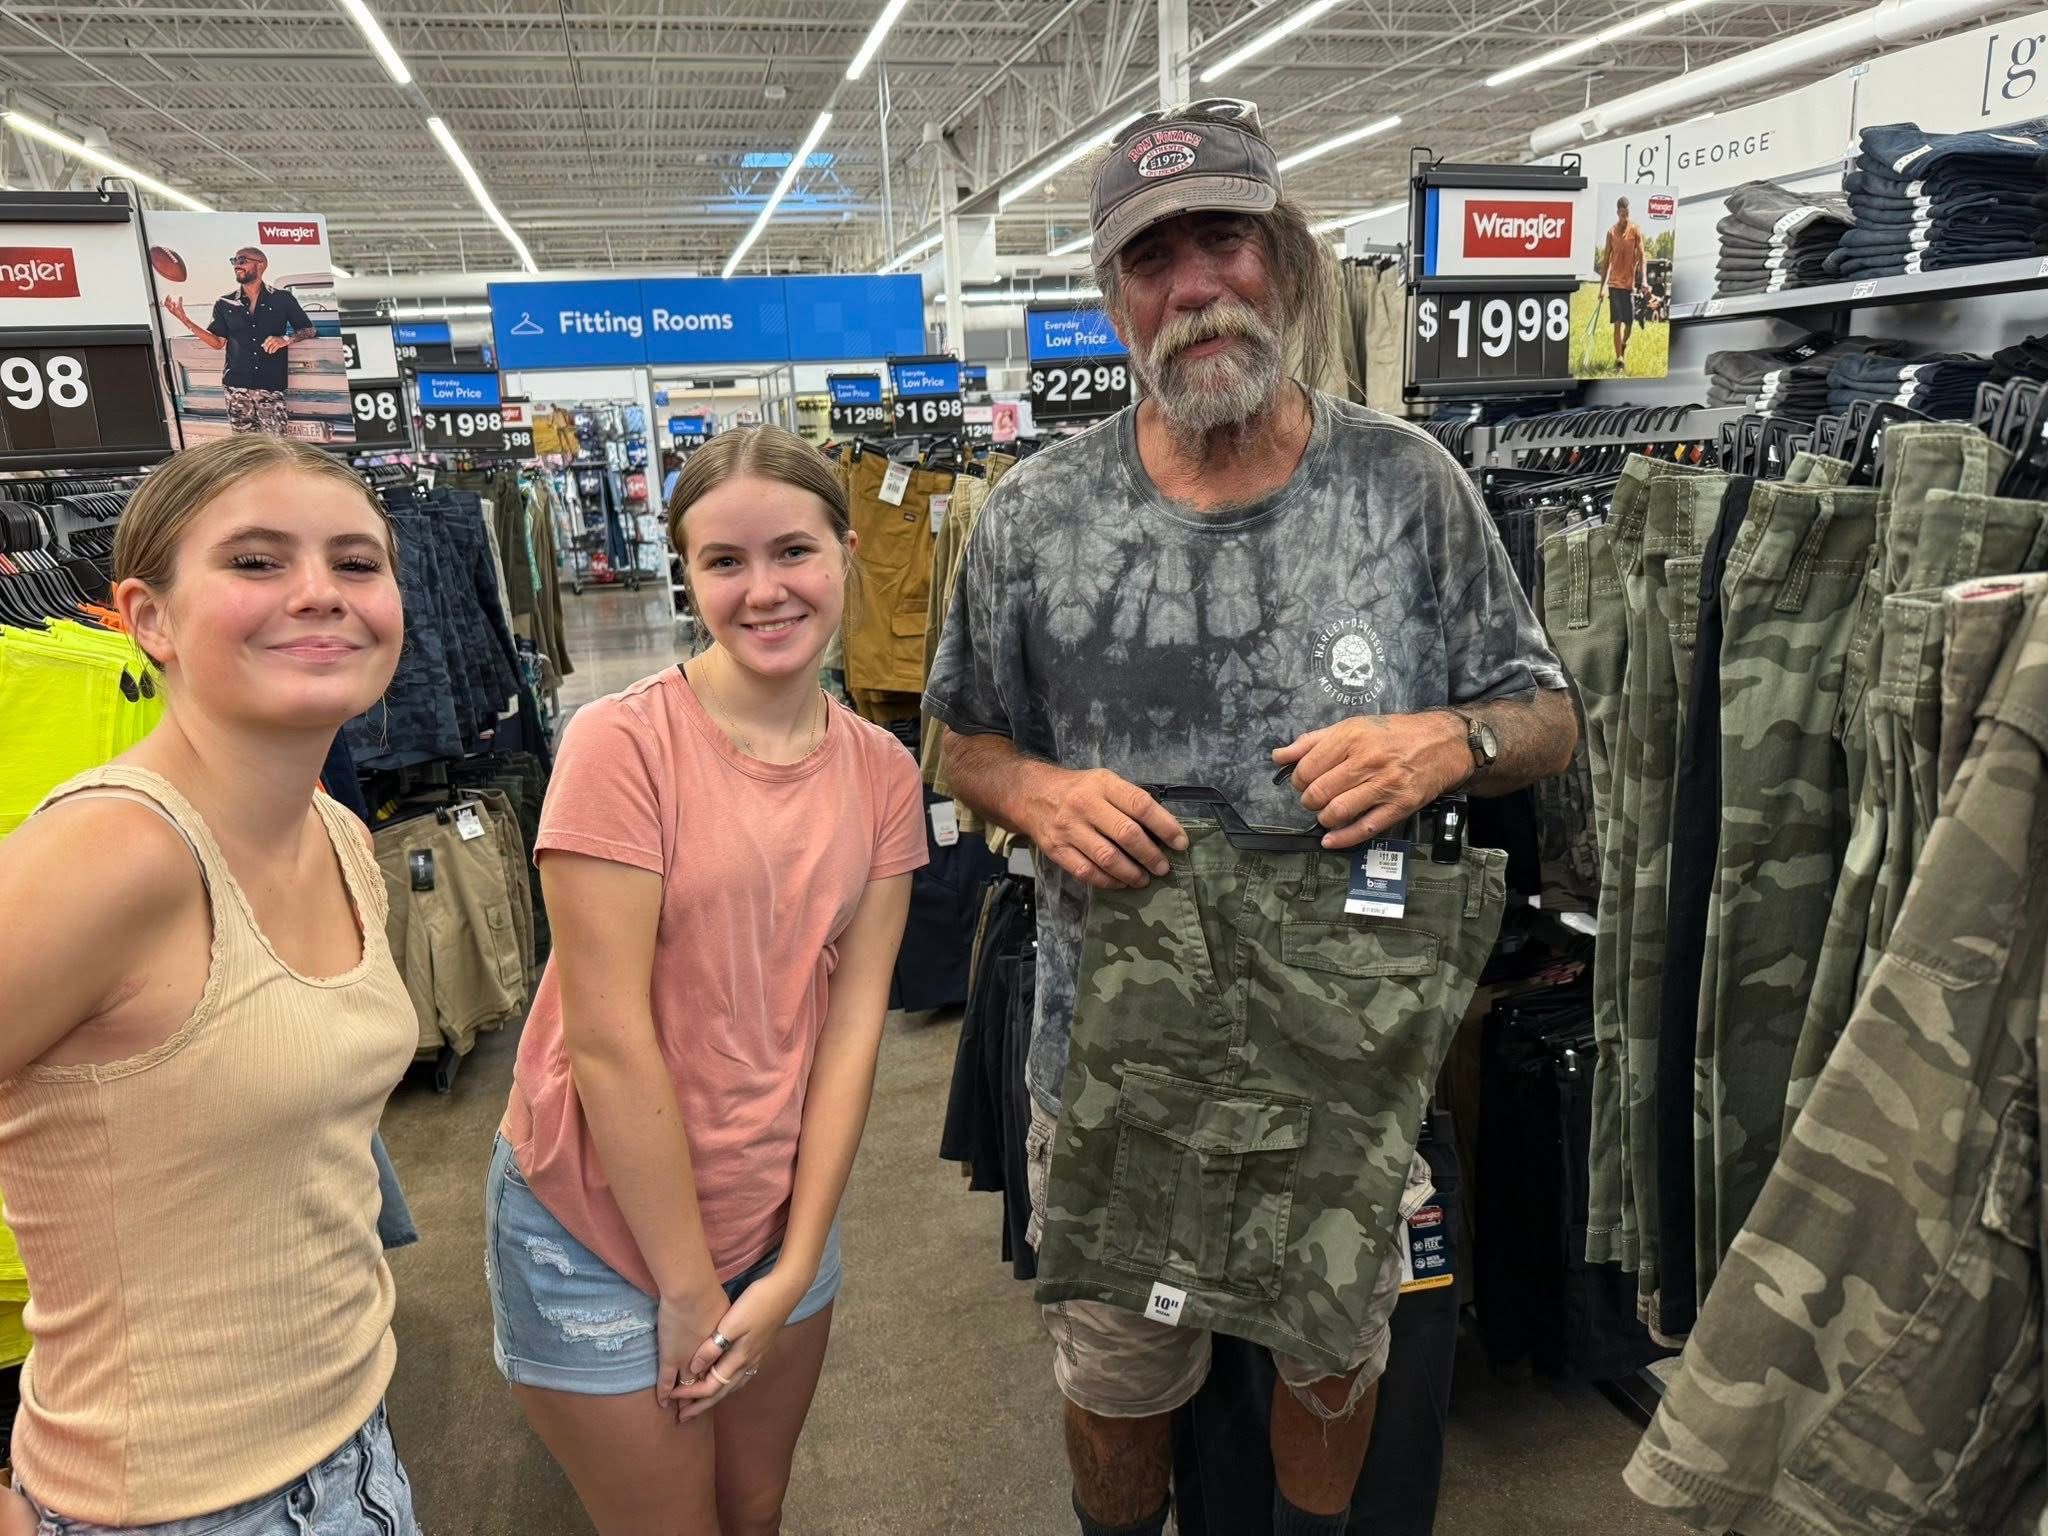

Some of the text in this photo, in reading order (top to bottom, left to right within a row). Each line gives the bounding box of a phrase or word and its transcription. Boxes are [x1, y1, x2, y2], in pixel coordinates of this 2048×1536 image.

[262, 225, 315, 242] Wrangler
[1472, 212, 1565, 250] Wrangler
[559, 308, 733, 338] Fitting Rooms
[1044, 321, 1080, 331] Everyday
[1046, 332, 1107, 348] Low Price
[0, 355, 89, 410] 98
[433, 387, 482, 399] Low Price
[903, 378, 945, 388] Low Price
[1314, 617, 1385, 662] HARLEY-DAVIDSON
[1318, 678, 1386, 706] MOTORCYCLES
